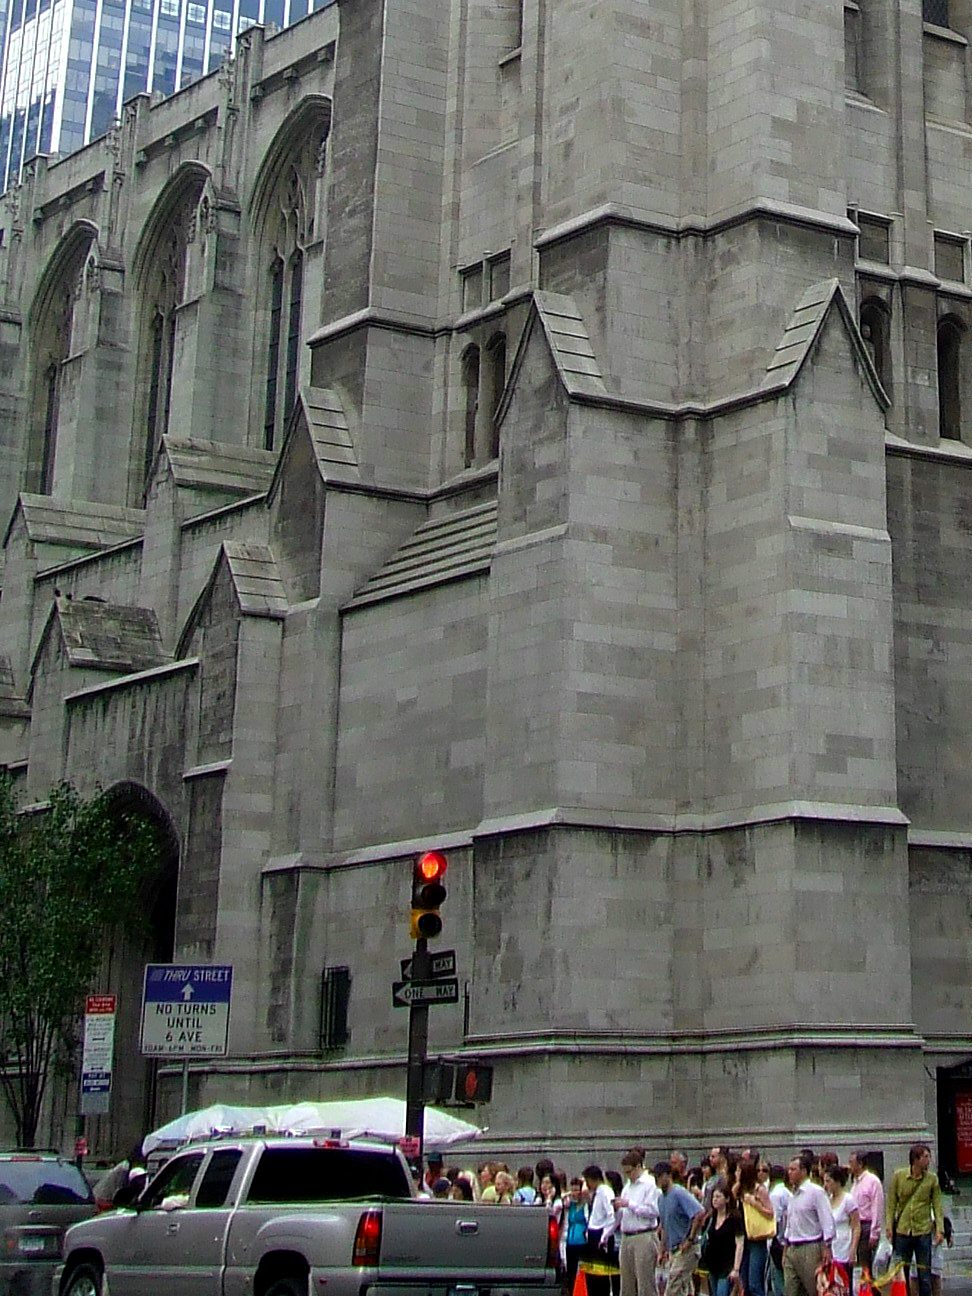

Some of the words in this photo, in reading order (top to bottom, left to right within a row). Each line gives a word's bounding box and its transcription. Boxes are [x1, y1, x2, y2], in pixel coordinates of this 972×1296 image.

[163, 969, 191, 981] THRU
[194, 969, 229, 981] STREET
[156, 1004, 172, 1015] NO
[178, 1004, 217, 1015] TURNS
[167, 1017, 203, 1029] UNTIL
[165, 1031, 173, 1042] 6
[179, 1031, 203, 1043] AVE
